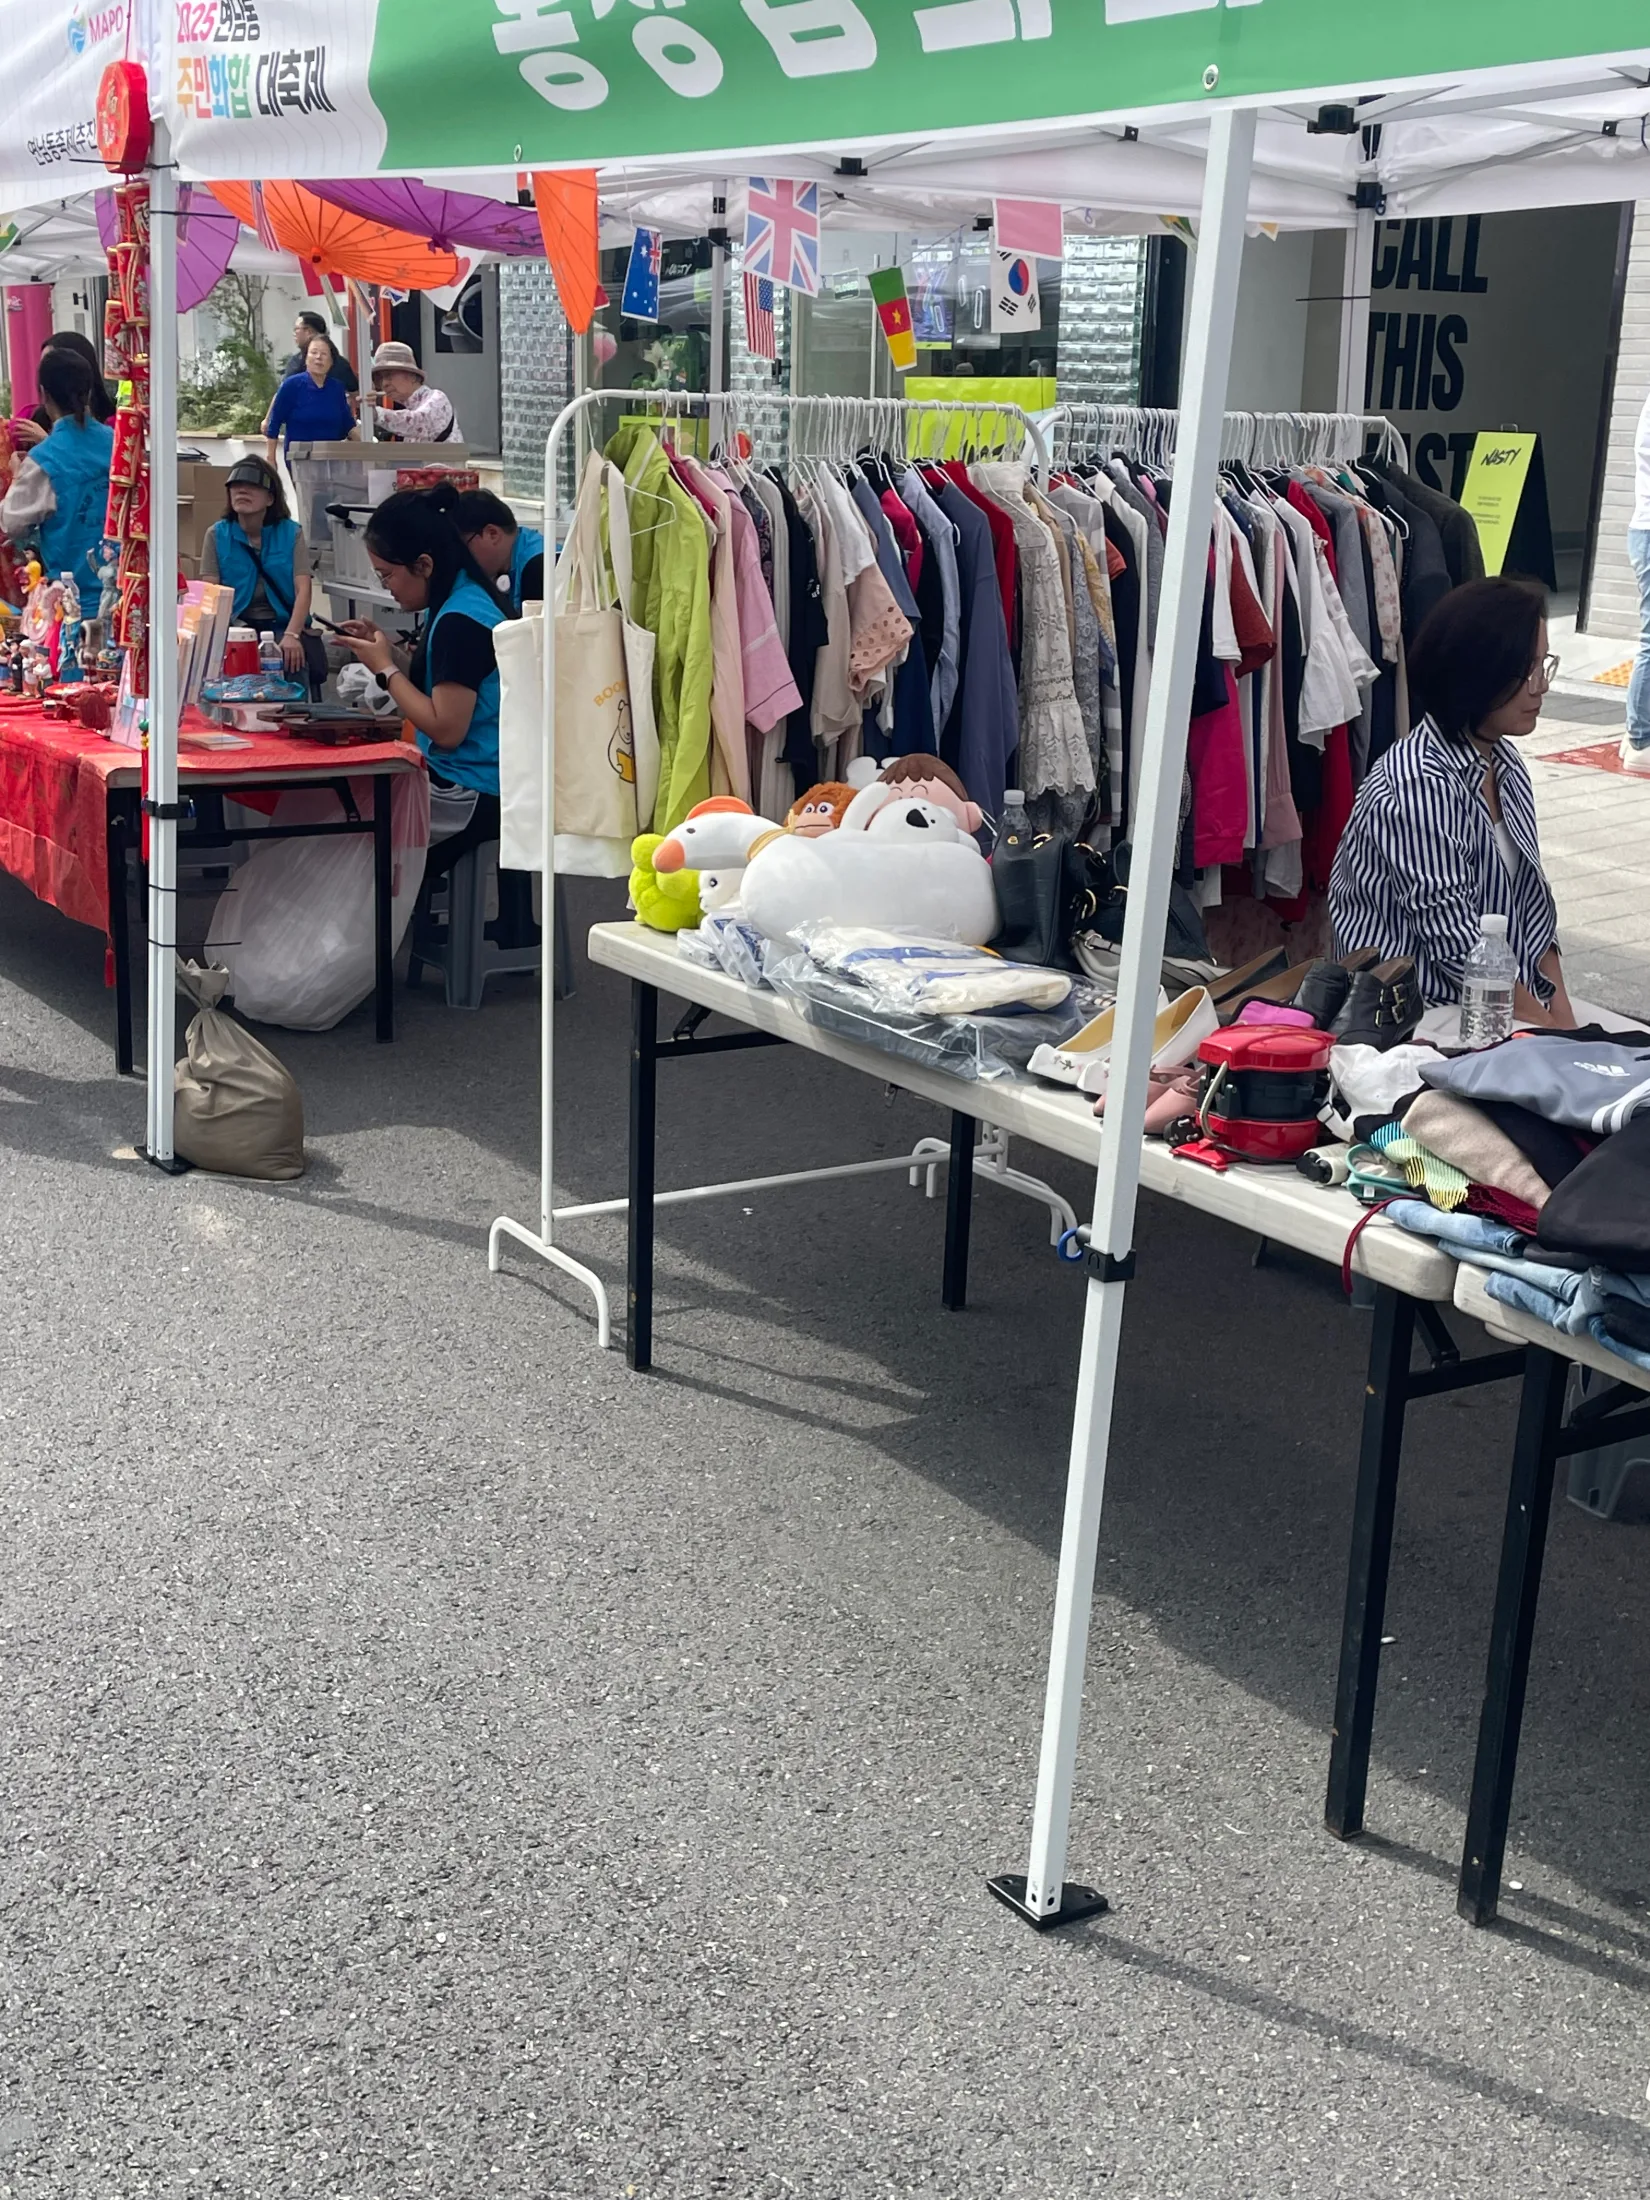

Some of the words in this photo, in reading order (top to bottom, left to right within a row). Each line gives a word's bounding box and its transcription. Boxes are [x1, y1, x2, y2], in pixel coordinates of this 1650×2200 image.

[89, 5, 124, 44] MAPO
[213, 0, 261, 42] 연남동
[176, 53, 253, 119] 주민화합
[255, 45, 338, 117] 대축제
[1371, 214, 1488, 294] CALL
[1364, 311, 1468, 412] THIS
[1481, 447, 1522, 467] NASTY
